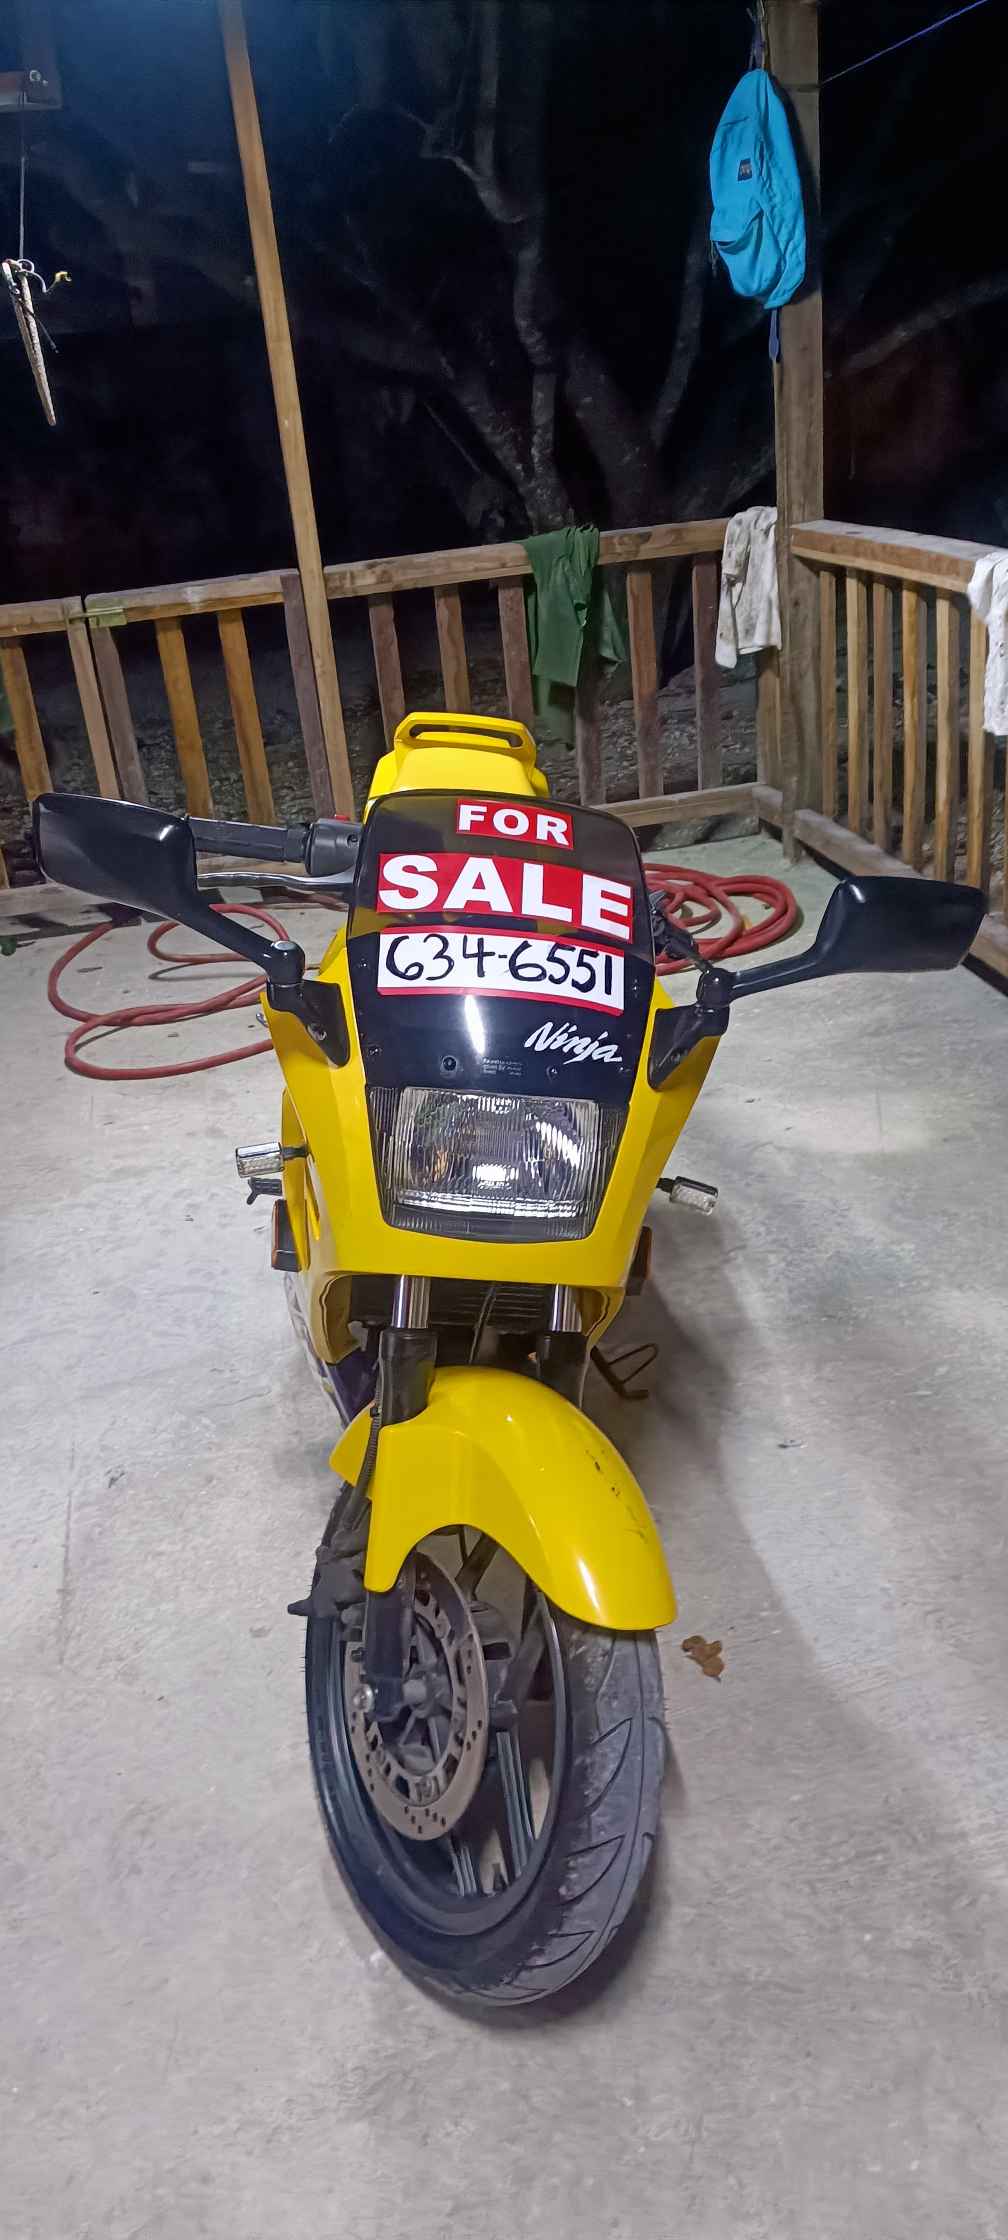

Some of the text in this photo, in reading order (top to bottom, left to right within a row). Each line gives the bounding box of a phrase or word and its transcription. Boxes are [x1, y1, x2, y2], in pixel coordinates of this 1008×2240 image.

[457, 804, 569, 846] FOR
[378, 854, 632, 940] SALE
[385, 934, 612, 995] 634-6551
[524, 1021, 623, 1065] Ninja
